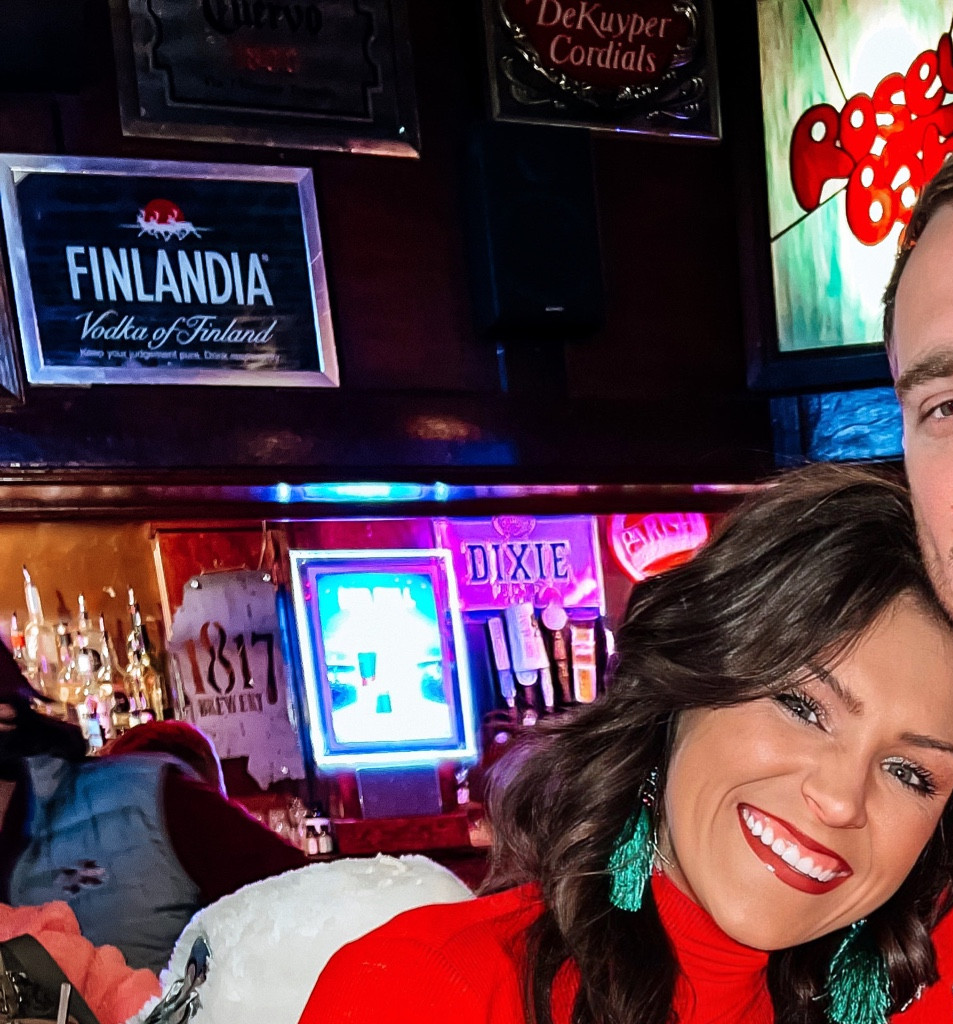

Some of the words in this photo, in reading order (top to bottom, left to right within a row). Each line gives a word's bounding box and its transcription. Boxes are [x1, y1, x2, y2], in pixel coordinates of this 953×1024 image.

[550, 34, 656, 73] Cordials
[66, 246, 274, 306] FINLANDIA
[75, 309, 149, 341] Vodka
[148, 316, 186, 350] of
[176, 315, 278, 345] Finland
[467, 542, 569, 583] DIXIE
[182, 620, 279, 706] 1817
